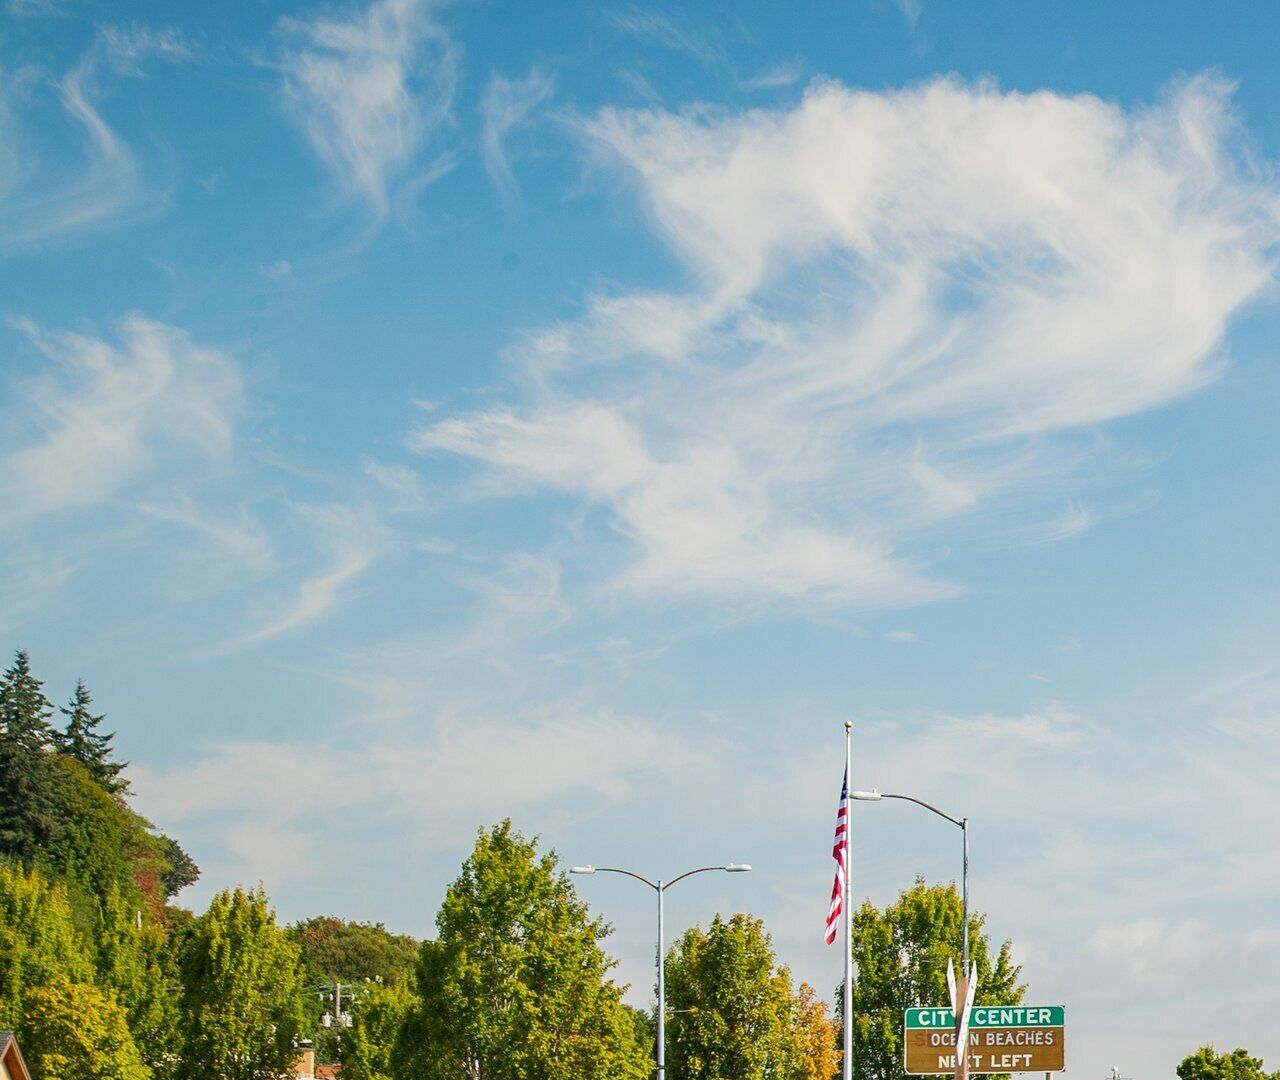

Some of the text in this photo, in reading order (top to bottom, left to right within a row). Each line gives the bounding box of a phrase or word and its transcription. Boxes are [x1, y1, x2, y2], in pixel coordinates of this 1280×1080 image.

[974, 1008, 1052, 1024] CENTER
[931, 1032, 1054, 1046] OCEN BEACHES
[938, 1054, 1033, 1068] NET LEFT
